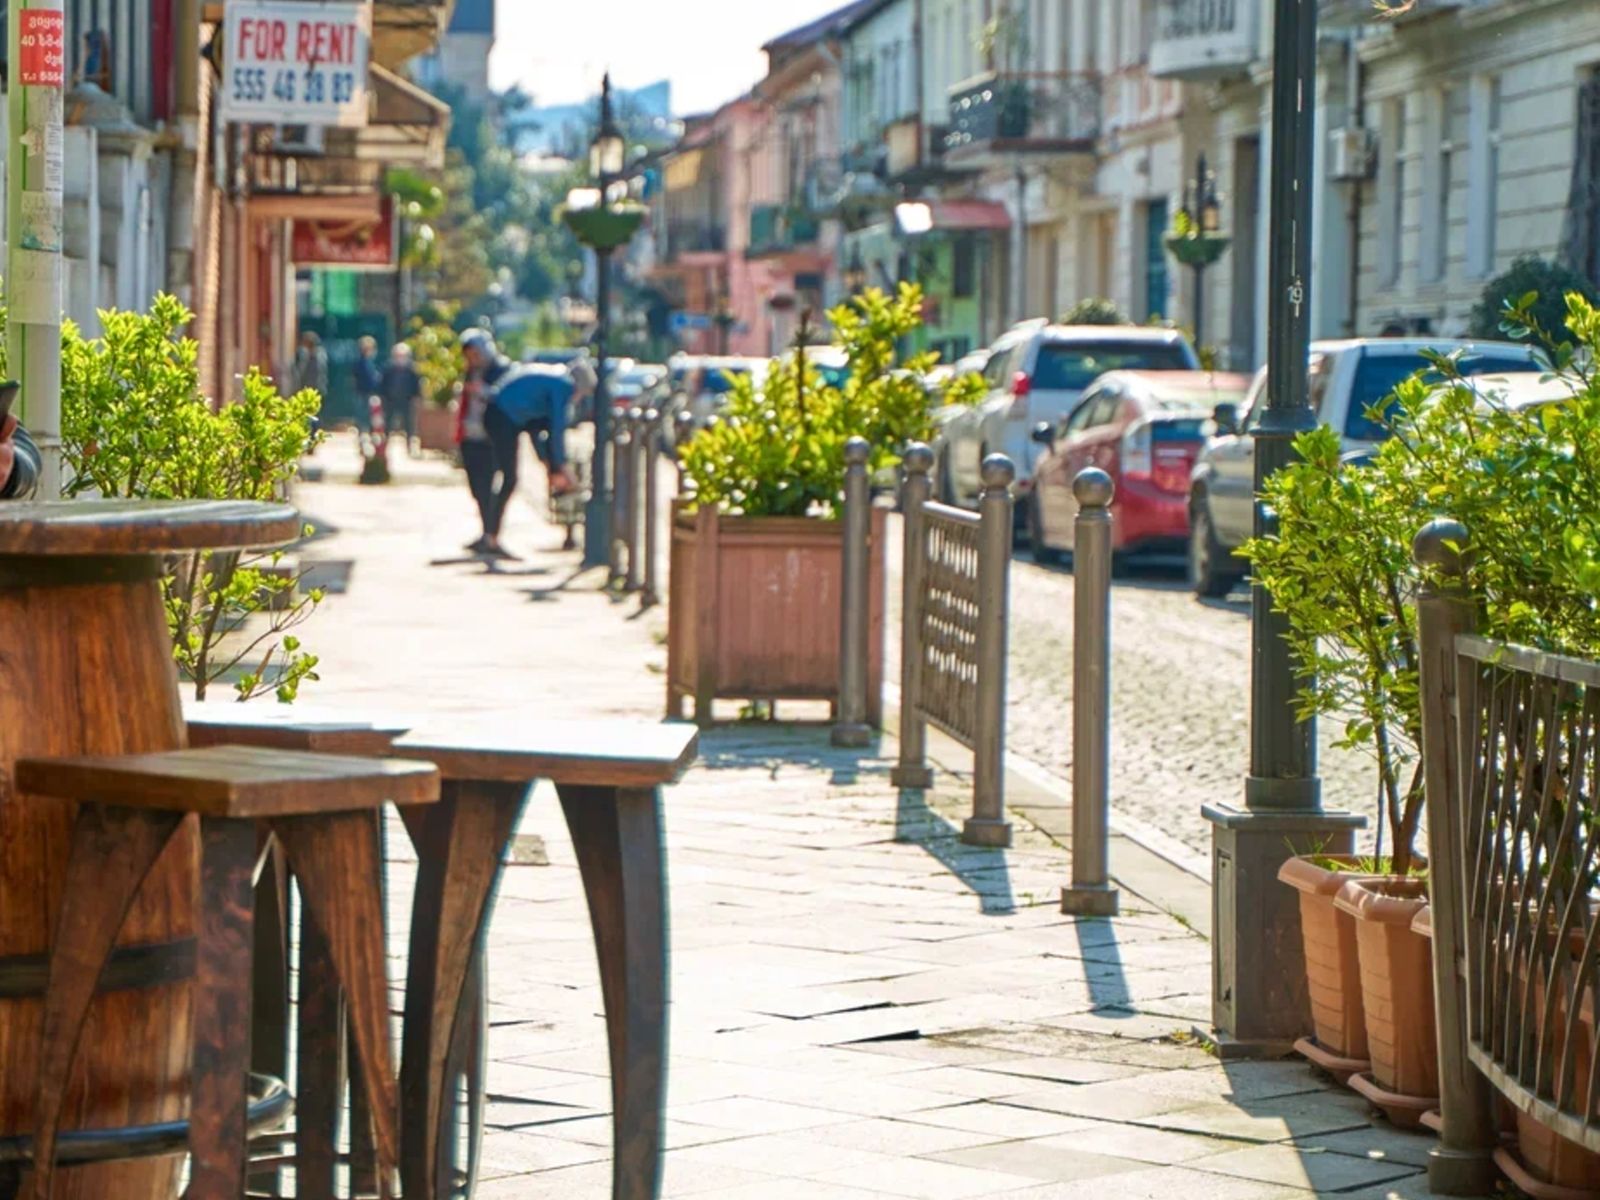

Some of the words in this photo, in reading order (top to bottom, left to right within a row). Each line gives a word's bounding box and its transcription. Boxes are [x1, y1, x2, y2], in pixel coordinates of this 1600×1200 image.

[21, 34, 35, 47] 40
[237, 16, 286, 61] FOR
[296, 20, 356, 64] RENT
[233, 67, 266, 100] 555
